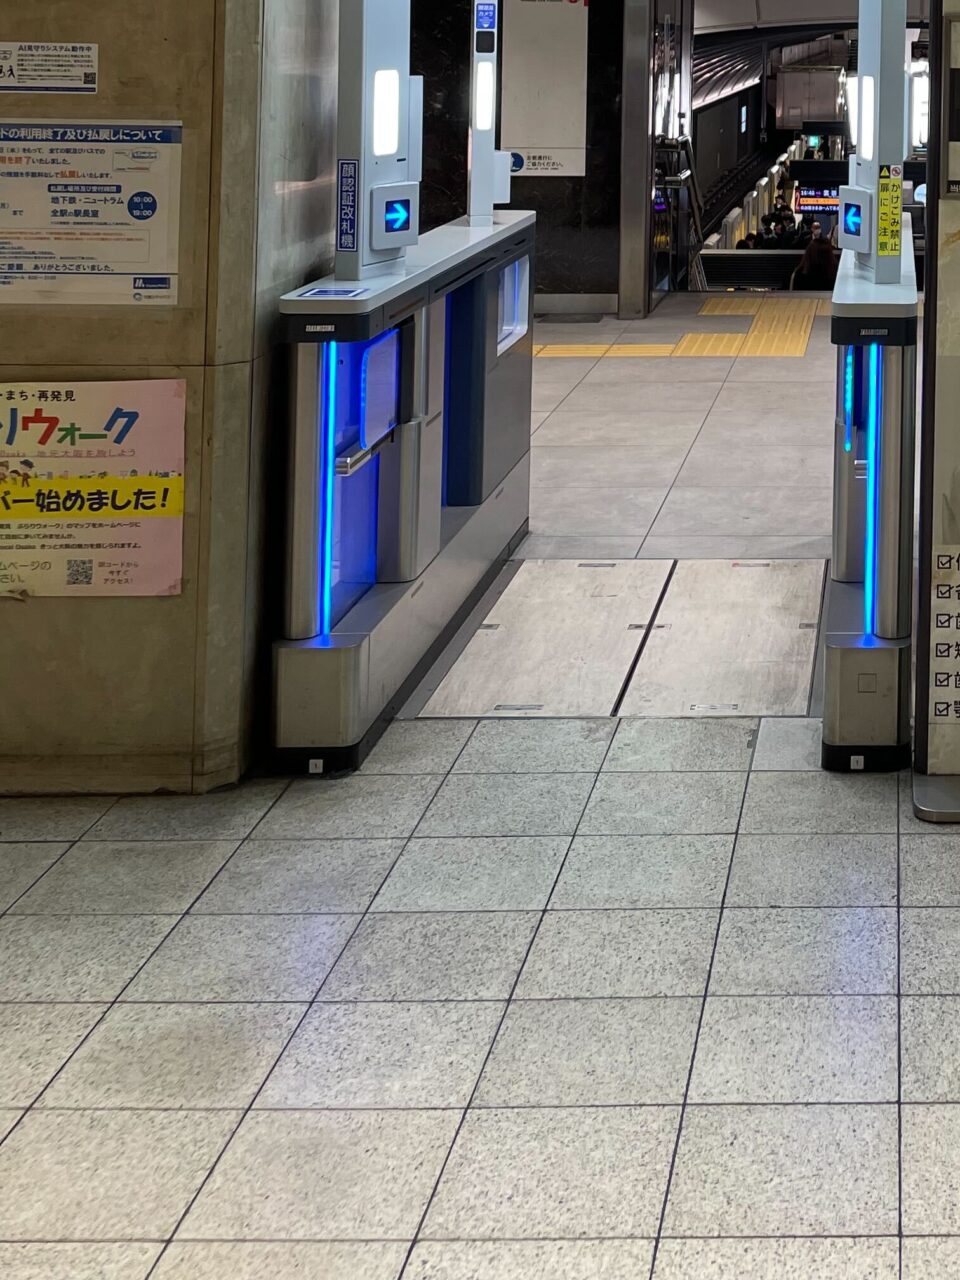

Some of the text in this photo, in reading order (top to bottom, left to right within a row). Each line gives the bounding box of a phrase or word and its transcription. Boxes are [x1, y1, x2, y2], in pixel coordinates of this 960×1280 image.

[340, 163, 355, 248] 顔認証改札機
[890, 182, 900, 252] かけこみ禁止
